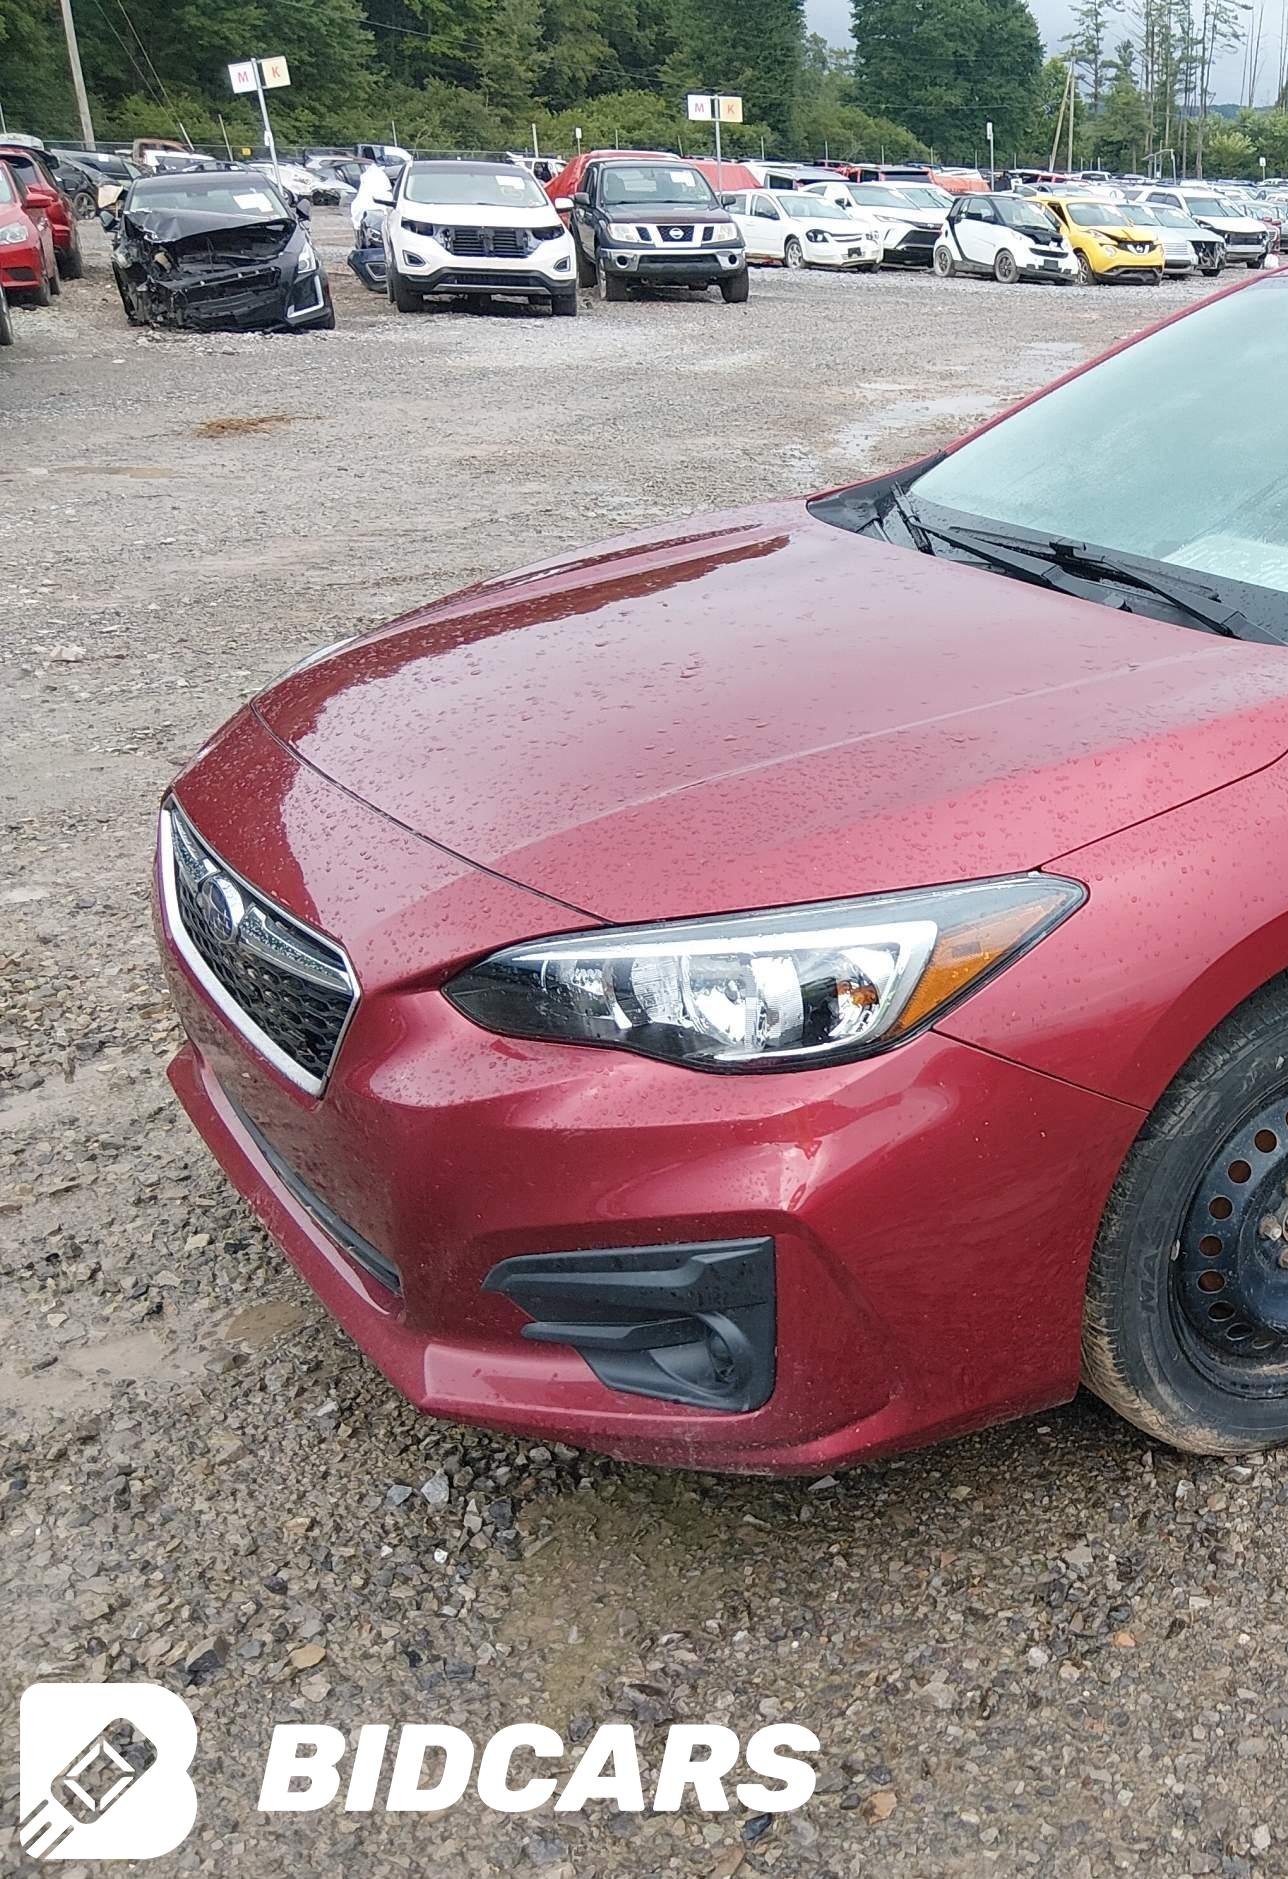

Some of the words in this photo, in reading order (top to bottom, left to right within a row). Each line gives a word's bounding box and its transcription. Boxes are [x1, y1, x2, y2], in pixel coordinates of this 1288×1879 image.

[237, 71, 249, 84] M
[271, 66, 281, 79] K
[694, 102, 705, 113] M
[727, 103, 736, 115] K
